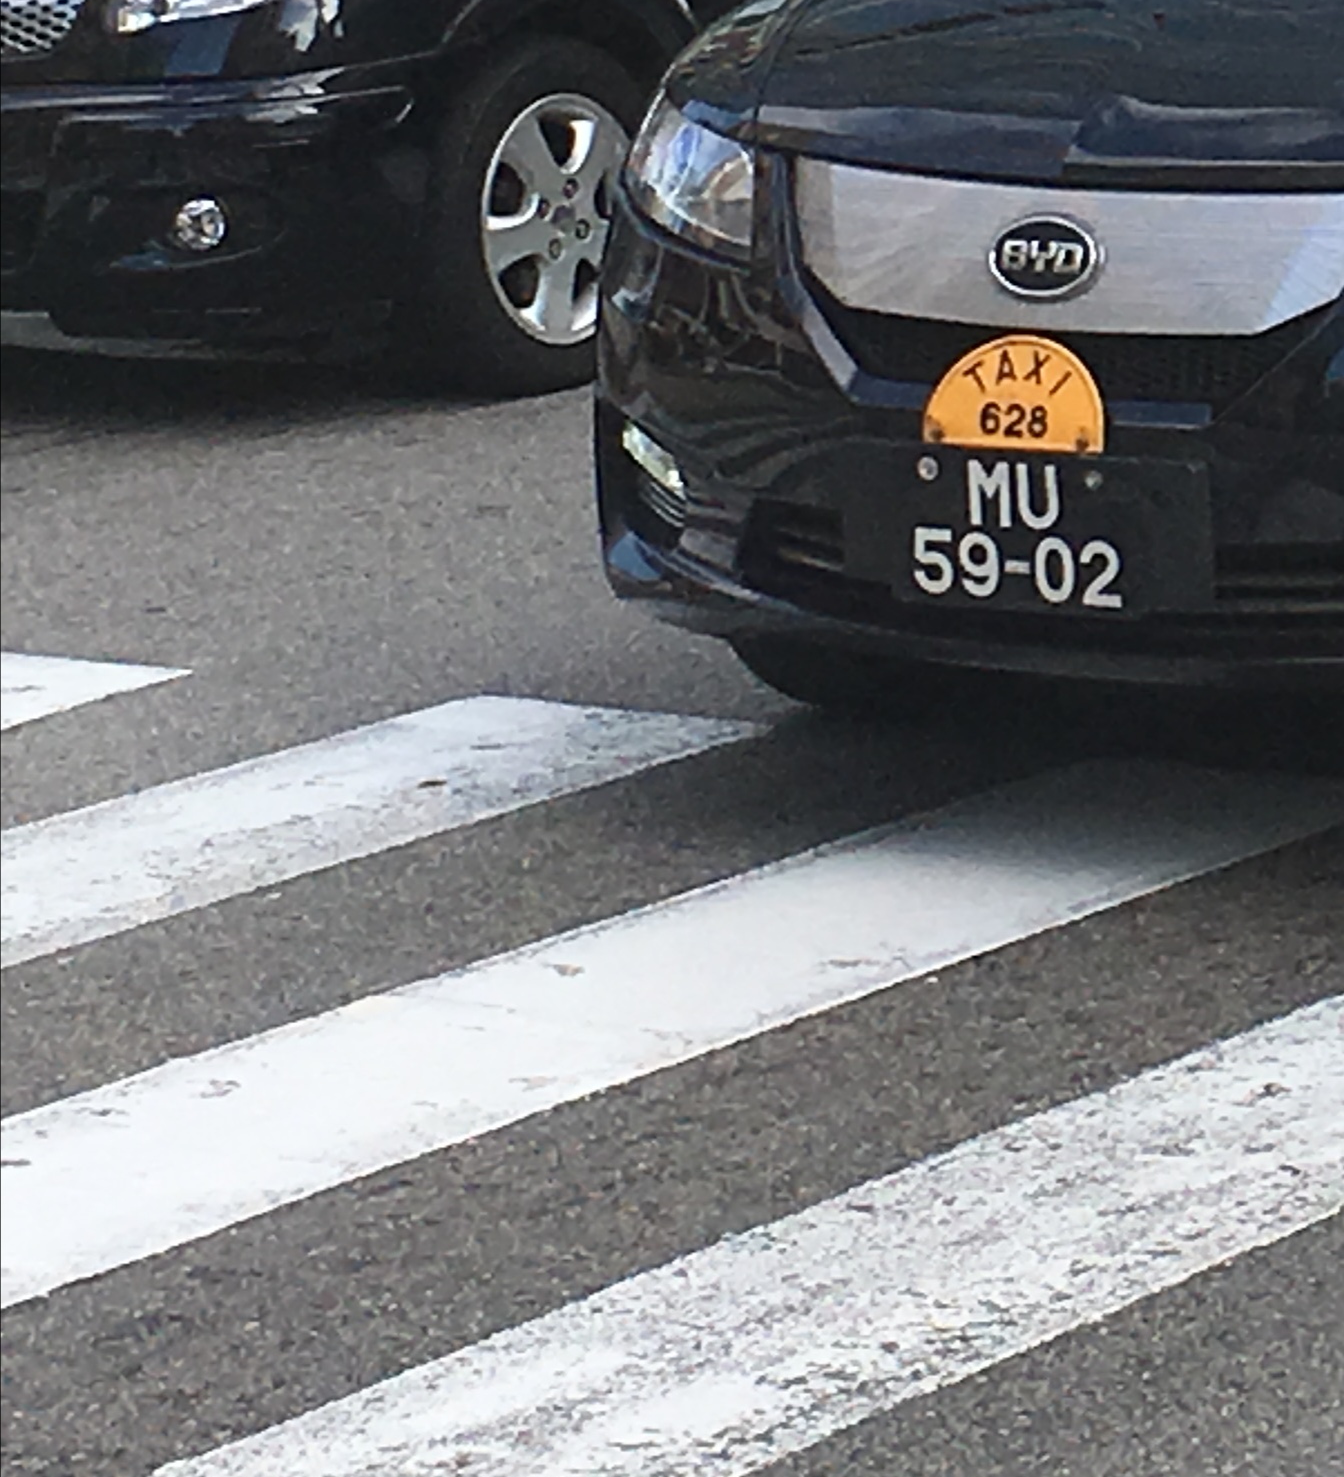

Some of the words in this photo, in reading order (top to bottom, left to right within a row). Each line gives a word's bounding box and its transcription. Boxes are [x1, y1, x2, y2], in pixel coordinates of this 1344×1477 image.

[1001, 238, 1084, 272] BYD
[963, 349, 1073, 396] TAXI
[979, 402, 1048, 439] 628
[967, 458, 1060, 530] MU
[912, 526, 1123, 608] 59-02
